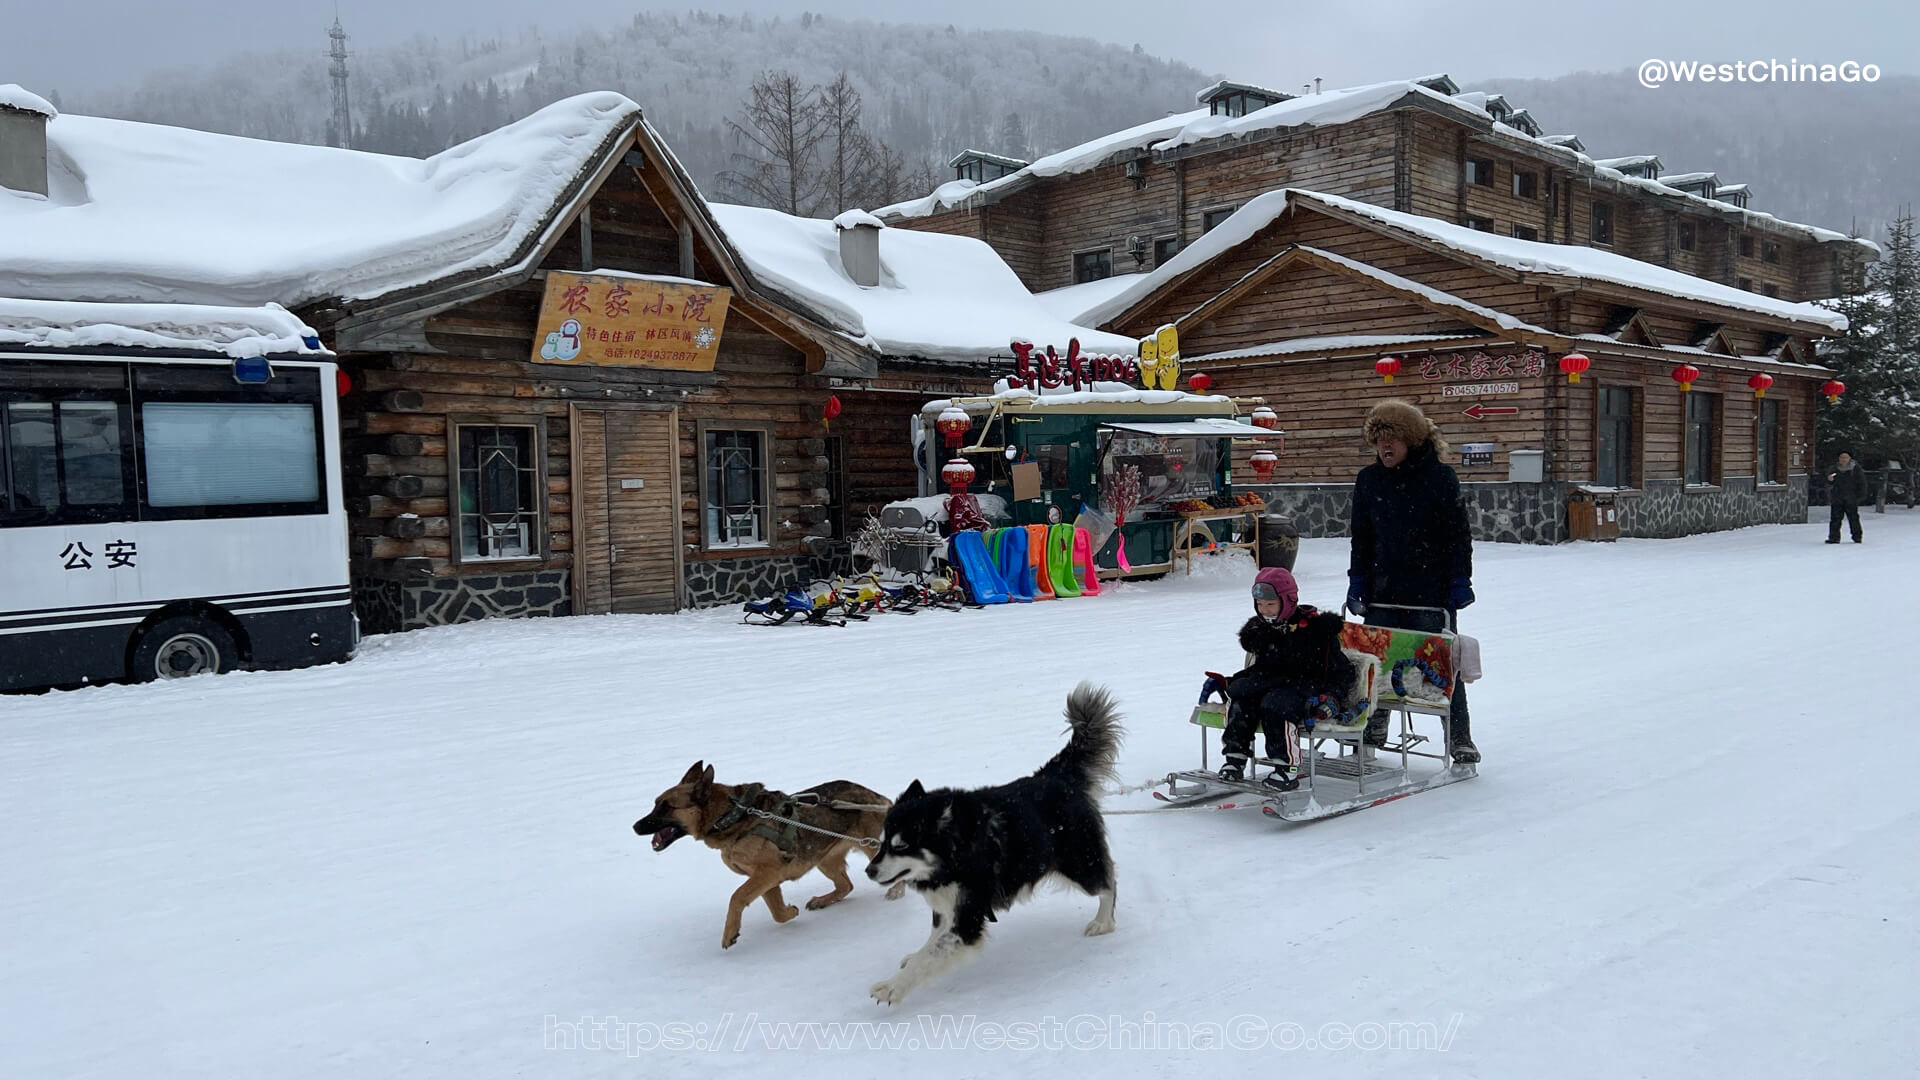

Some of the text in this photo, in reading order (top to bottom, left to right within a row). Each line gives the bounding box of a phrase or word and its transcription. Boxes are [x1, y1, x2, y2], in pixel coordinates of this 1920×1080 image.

[559, 281, 713, 323] 农家小院
[586, 326, 693, 343] 特色住宿 林区风情
[1420, 350, 1544, 379] 艺术家公寓
[59, 539, 137, 571] 公安
